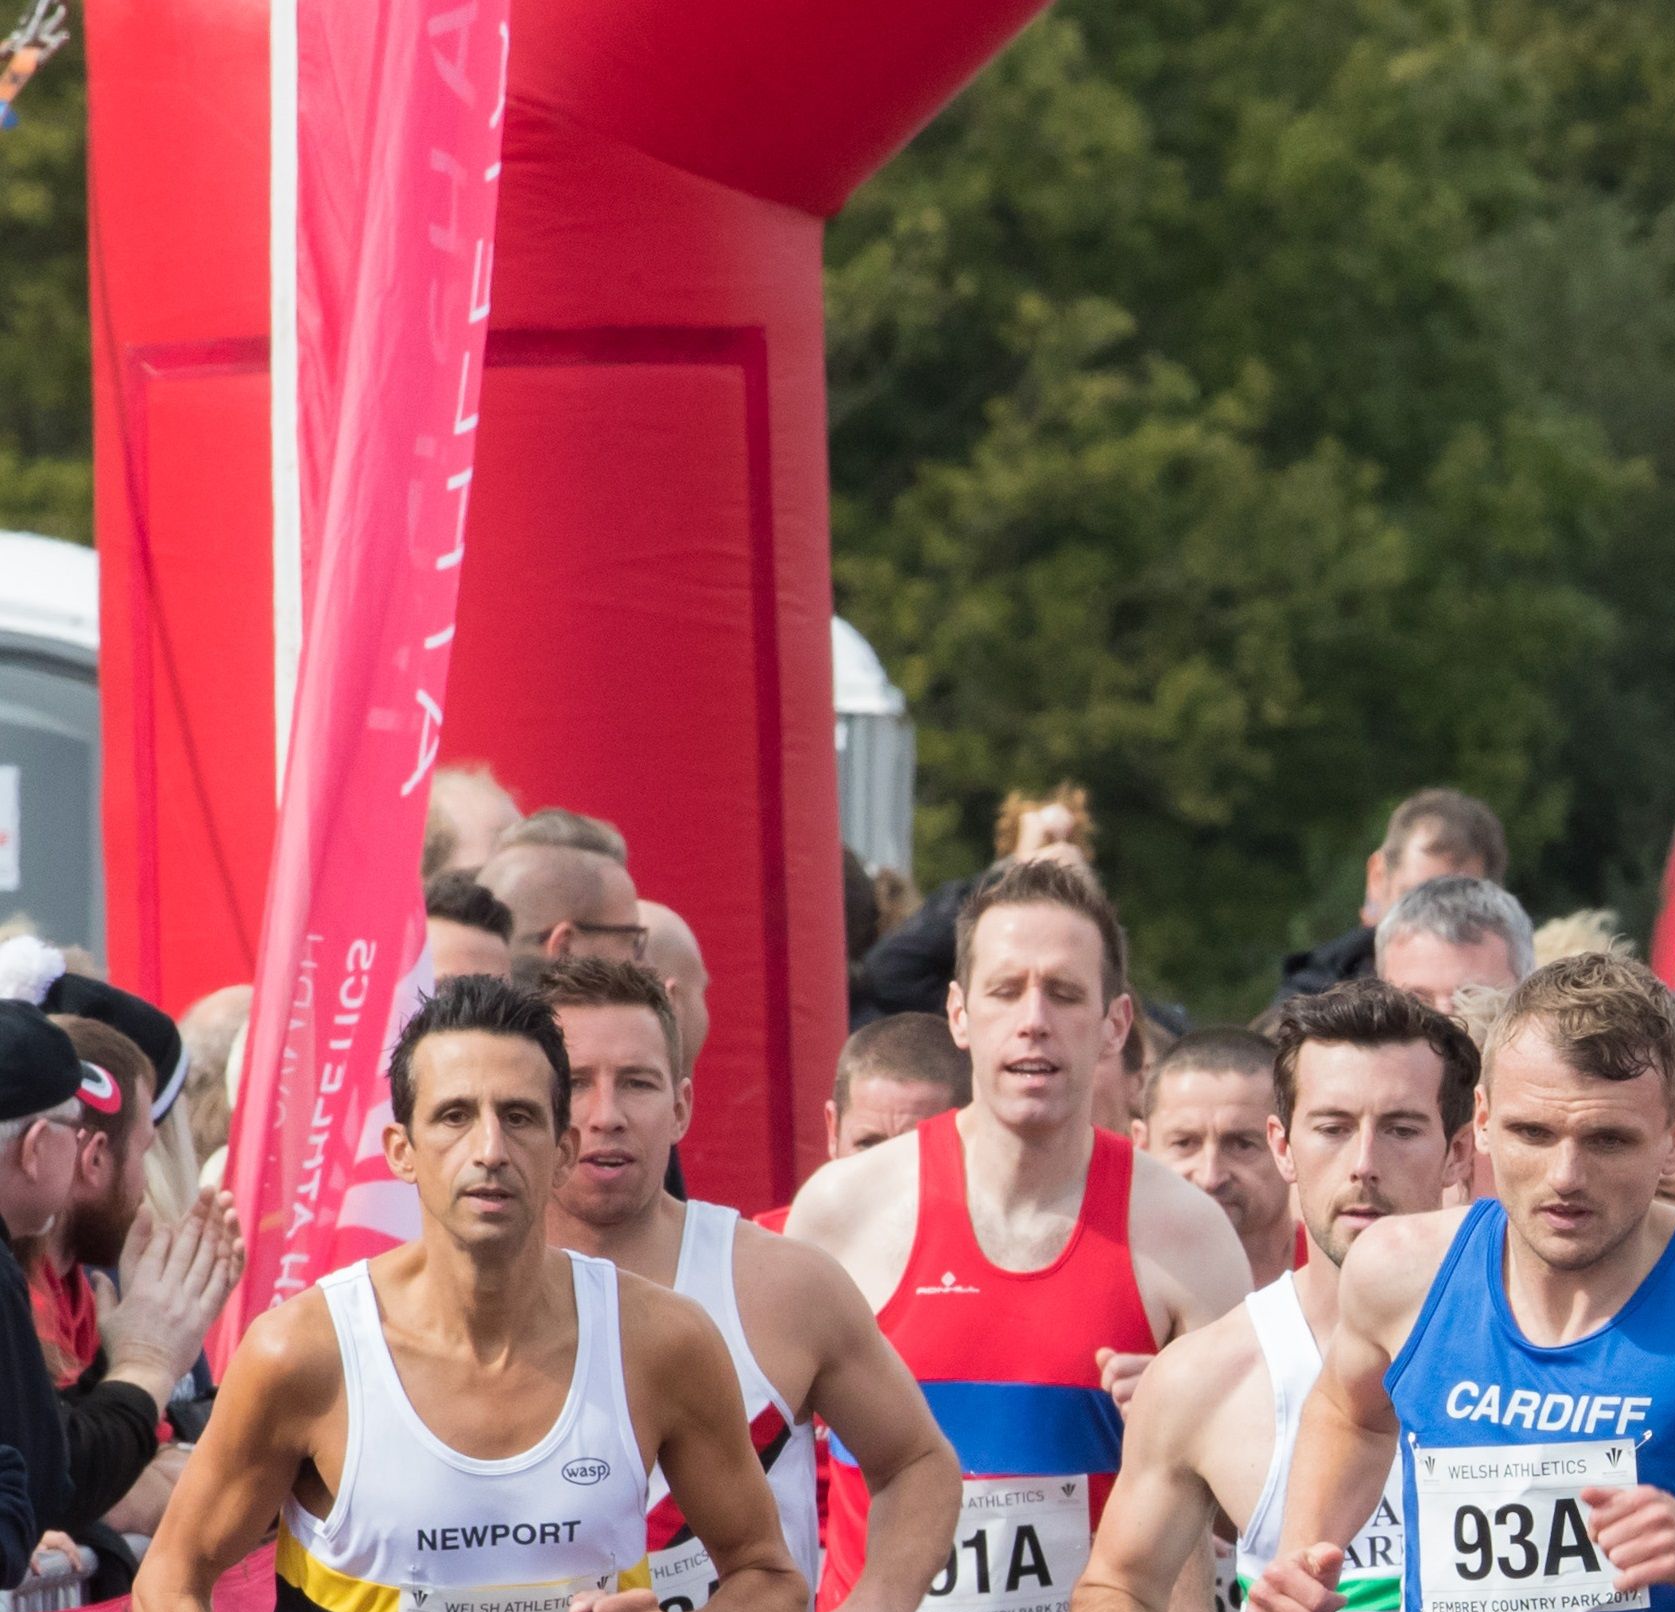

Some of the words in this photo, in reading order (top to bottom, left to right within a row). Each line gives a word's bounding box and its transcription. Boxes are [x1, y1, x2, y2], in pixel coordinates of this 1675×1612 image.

[1446, 1381, 1652, 1435] CARDIFF
[565, 1461, 610, 1481] wasp
[1449, 1465, 1499, 1479] WELSH
[1504, 1460, 1587, 1477] ATHLETICS
[968, 1491, 1045, 1508] ATHLETICS
[417, 1520, 581, 1551] NEWPORT
[1453, 1498, 1601, 1581] 93A
[650, 1549, 709, 1579] HLETICS
[1492, 1597, 1557, 1612] COUNTRY
[1562, 1593, 1601, 1608] PARK
[1606, 1590, 1638, 1605] 2017
